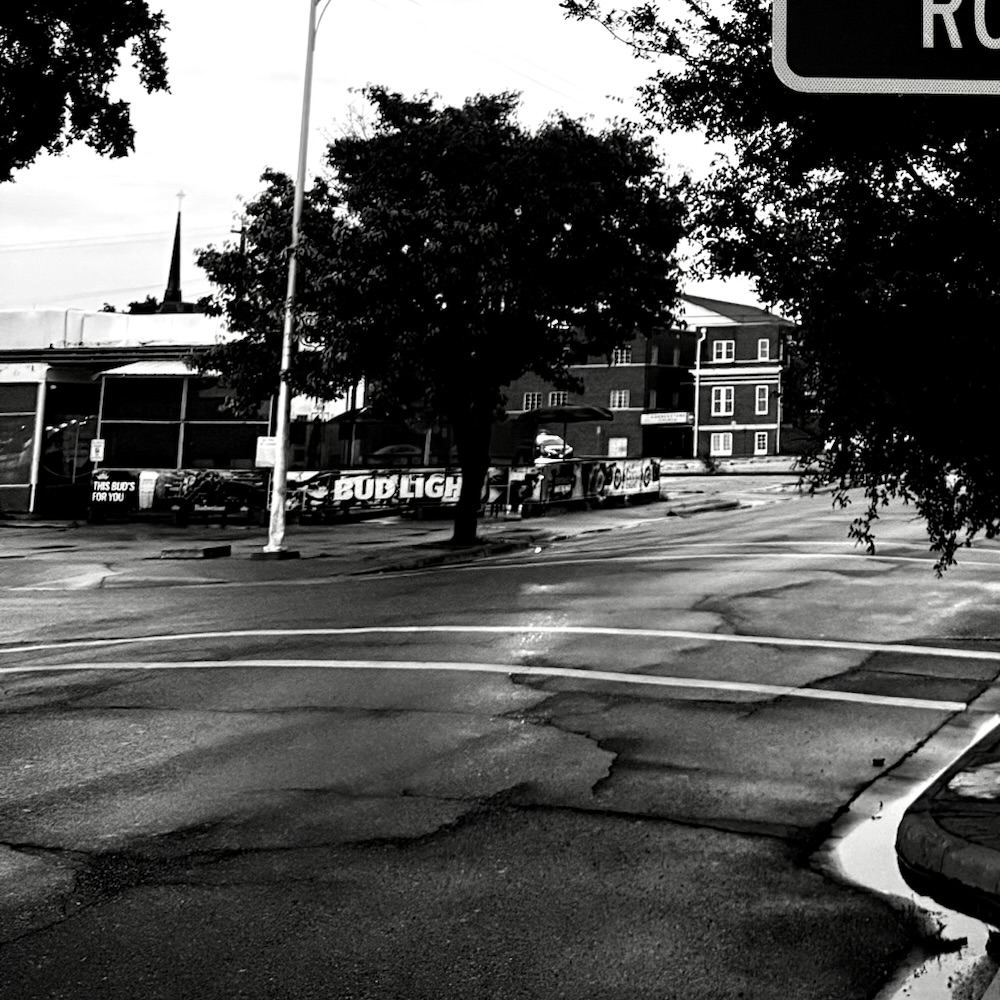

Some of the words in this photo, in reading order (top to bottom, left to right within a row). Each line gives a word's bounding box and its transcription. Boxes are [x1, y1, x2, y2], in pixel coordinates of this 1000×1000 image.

[93, 481, 110, 491] THIS
[111, 482, 135, 491] BUD'S
[333, 475, 398, 501] BUD
[399, 474, 463, 502] LIGH
[92, 492, 107, 502] FOR
[108, 492, 125, 502] YOU
